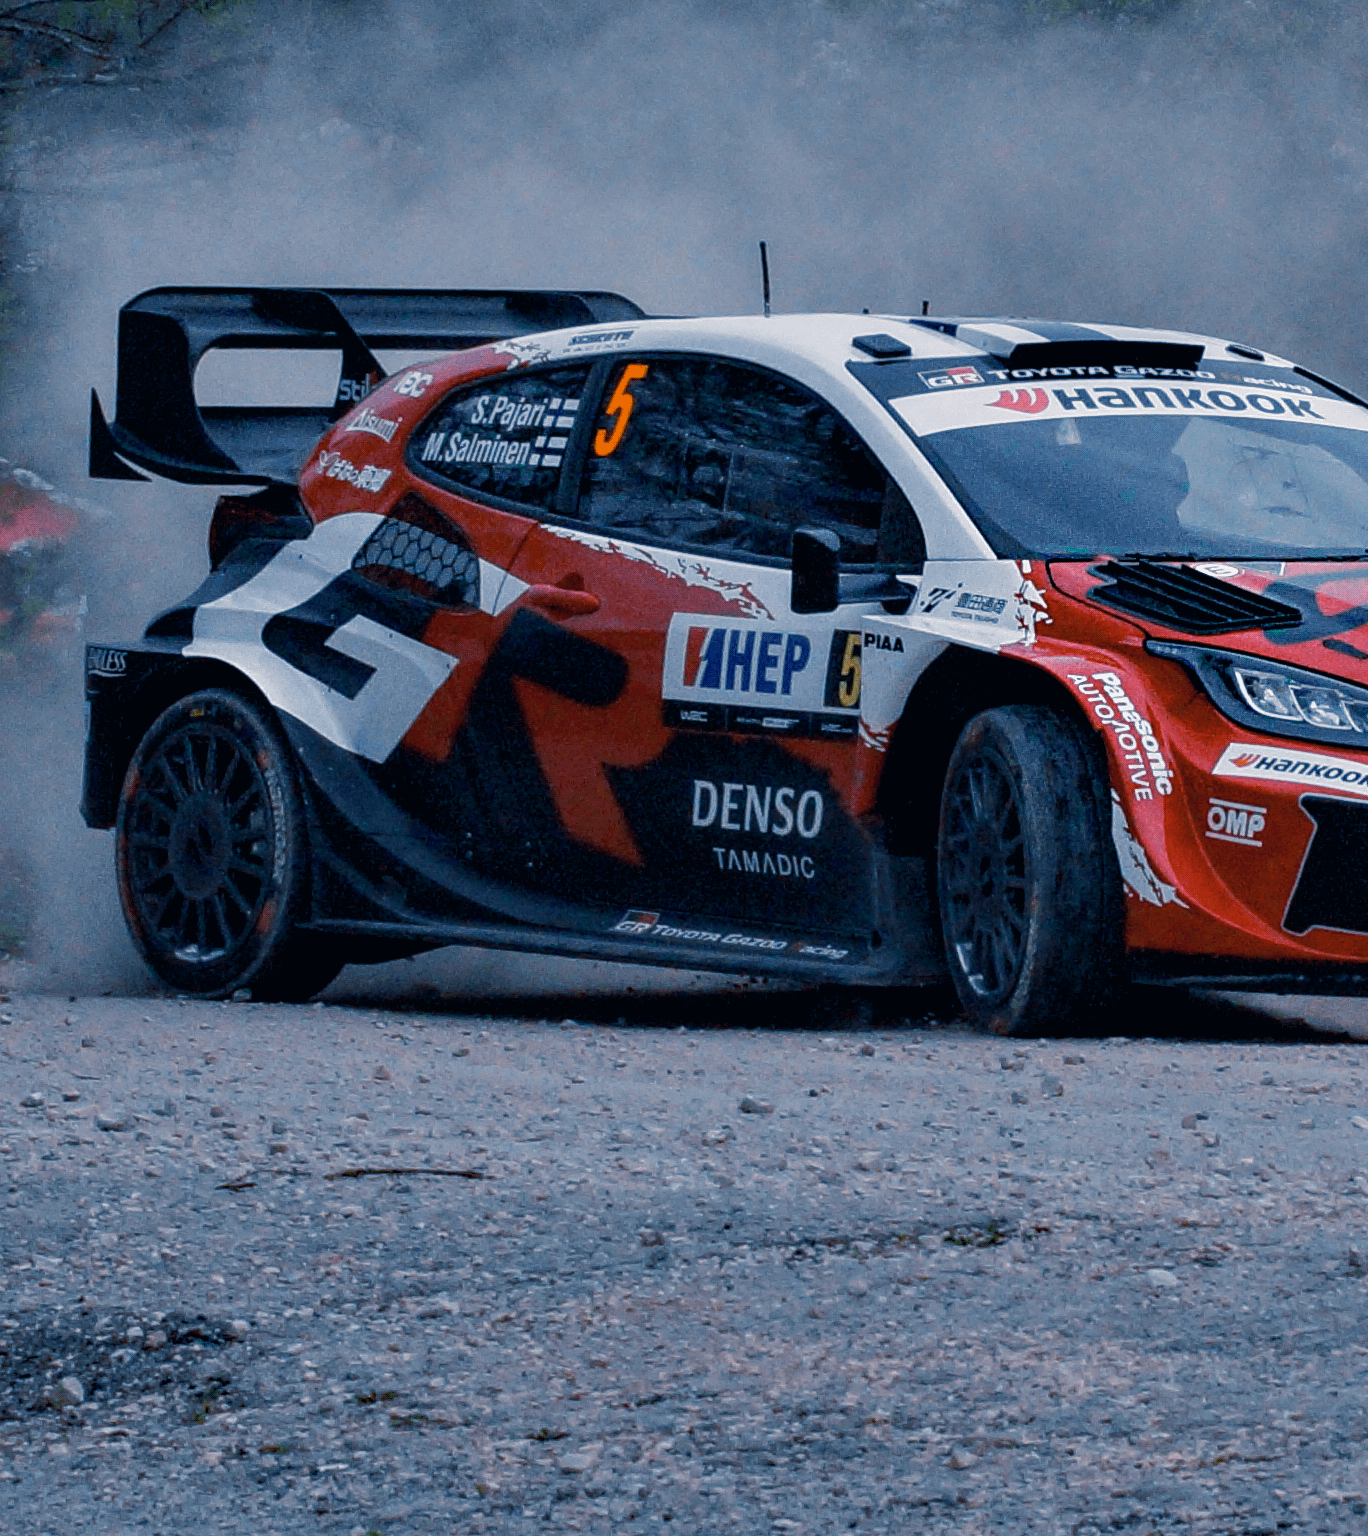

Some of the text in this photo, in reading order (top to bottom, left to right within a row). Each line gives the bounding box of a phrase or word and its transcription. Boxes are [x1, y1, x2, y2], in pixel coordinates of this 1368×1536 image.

[339, 373, 377, 402] Stil
[927, 372, 979, 388] GR
[987, 366, 1110, 380] TOYOTA
[471, 394, 548, 431] S.Pajari
[594, 363, 649, 457] 5
[421, 431, 531, 466] M.Salminen
[864, 633, 905, 653] PIAA
[838, 632, 862, 707] 5
[1066, 673, 1154, 801] AUTOMOTIVE
[1091, 672, 1174, 796] Panasonic
[692, 779, 824, 839] DENSO
[1207, 805, 1266, 838] OMP
[712, 847, 815, 879] TAMADIC
[615, 920, 652, 934] GR
[651, 924, 722, 942] TOYOTA
